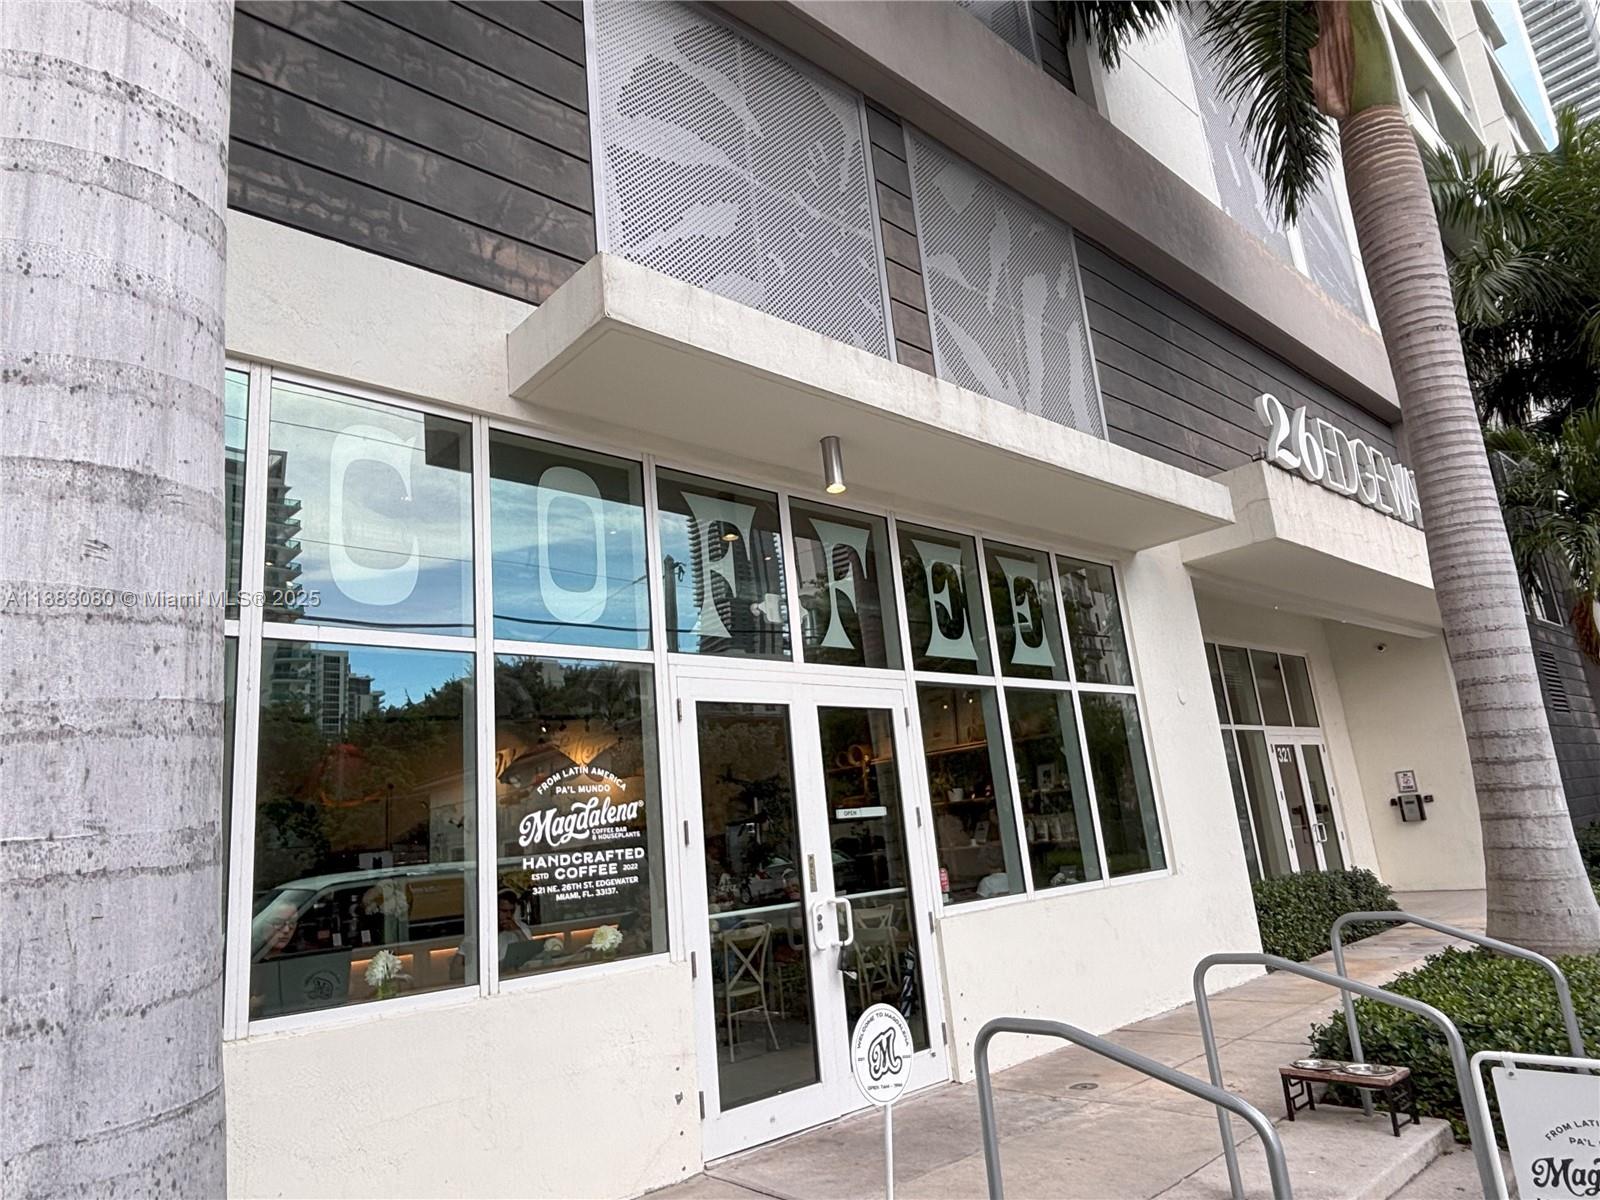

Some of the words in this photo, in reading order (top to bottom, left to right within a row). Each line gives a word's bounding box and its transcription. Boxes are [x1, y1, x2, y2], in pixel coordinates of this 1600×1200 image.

[328, 424, 1057, 667] COFFEE
[1277, 747, 1291, 762] 321
[537, 772, 562, 795] FROM
[562, 766, 589, 778] LATIN
[591, 767, 627, 792] AMERICA
[555, 785, 576, 795] PA'L
[578, 784, 611, 793] MUNDO
[591, 827, 614, 835] COFFEE
[598, 830, 641, 840] HOUSEPLANTS
[522, 847, 645, 870] HANDCRAFTED
[531, 873, 549, 881] ESTD
[554, 863, 618, 880] COFFEE
[622, 863, 638, 871] 2022
[532, 886, 546, 895] 321
[562, 883, 582, 892] 26TH
[595, 876, 639, 888] EDGEWATER
[857, 1015, 875, 1048] WELCOME
[1545, 1122, 1573, 1141] FROM
[1573, 1119, 1600, 1128] LATI
[1569, 1136, 1596, 1147] PA'L
[1531, 1157, 1600, 1197] Mag
